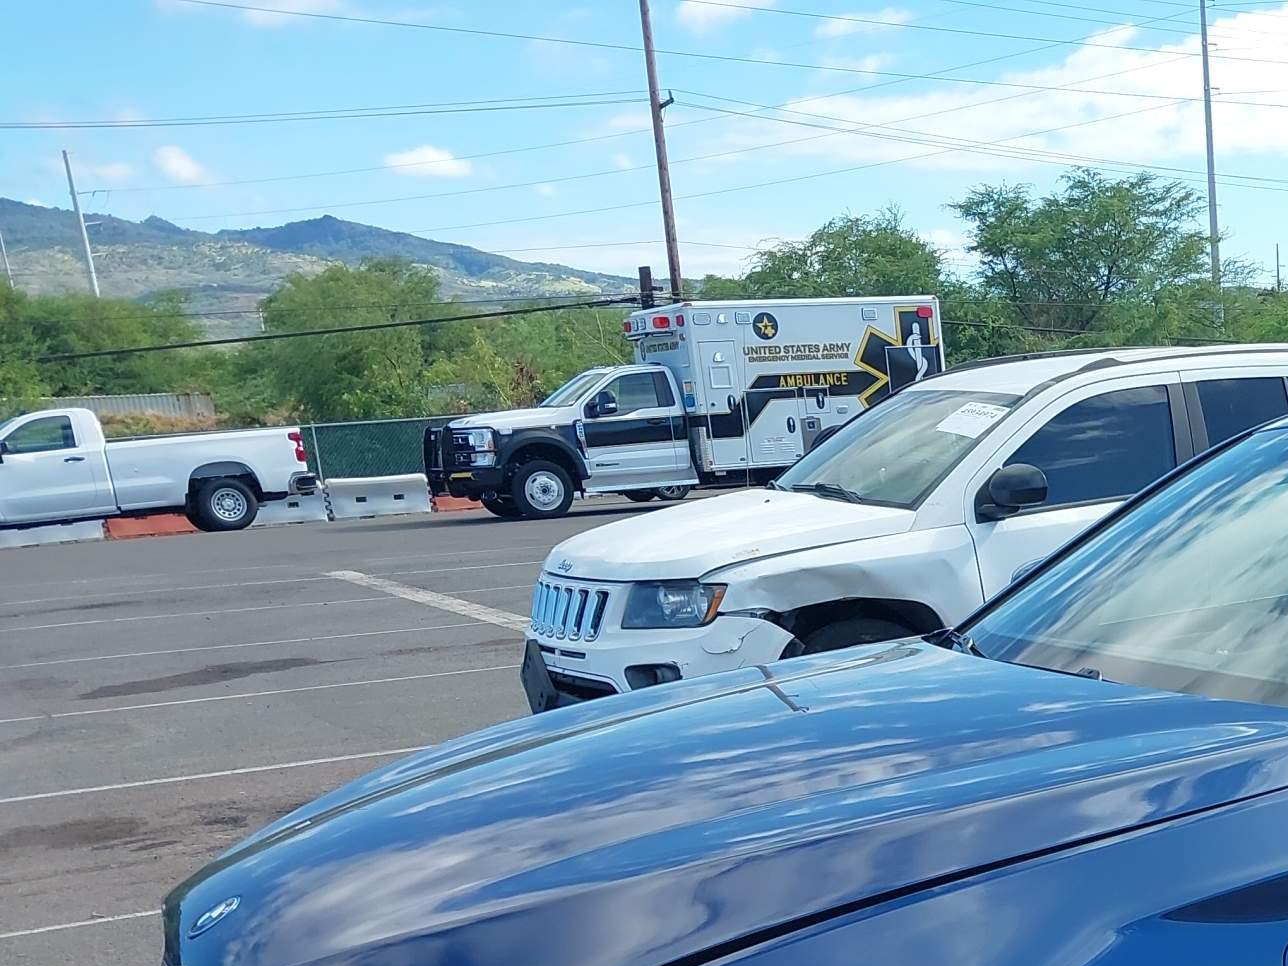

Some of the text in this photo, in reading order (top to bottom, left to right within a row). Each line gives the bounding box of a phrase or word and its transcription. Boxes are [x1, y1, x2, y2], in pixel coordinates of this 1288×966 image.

[743, 342, 851, 355] UNITED STATES ARMY
[748, 352, 849, 363] EMERGENCY MEDICAL SERVICE
[779, 372, 849, 388] AMBULANCE
